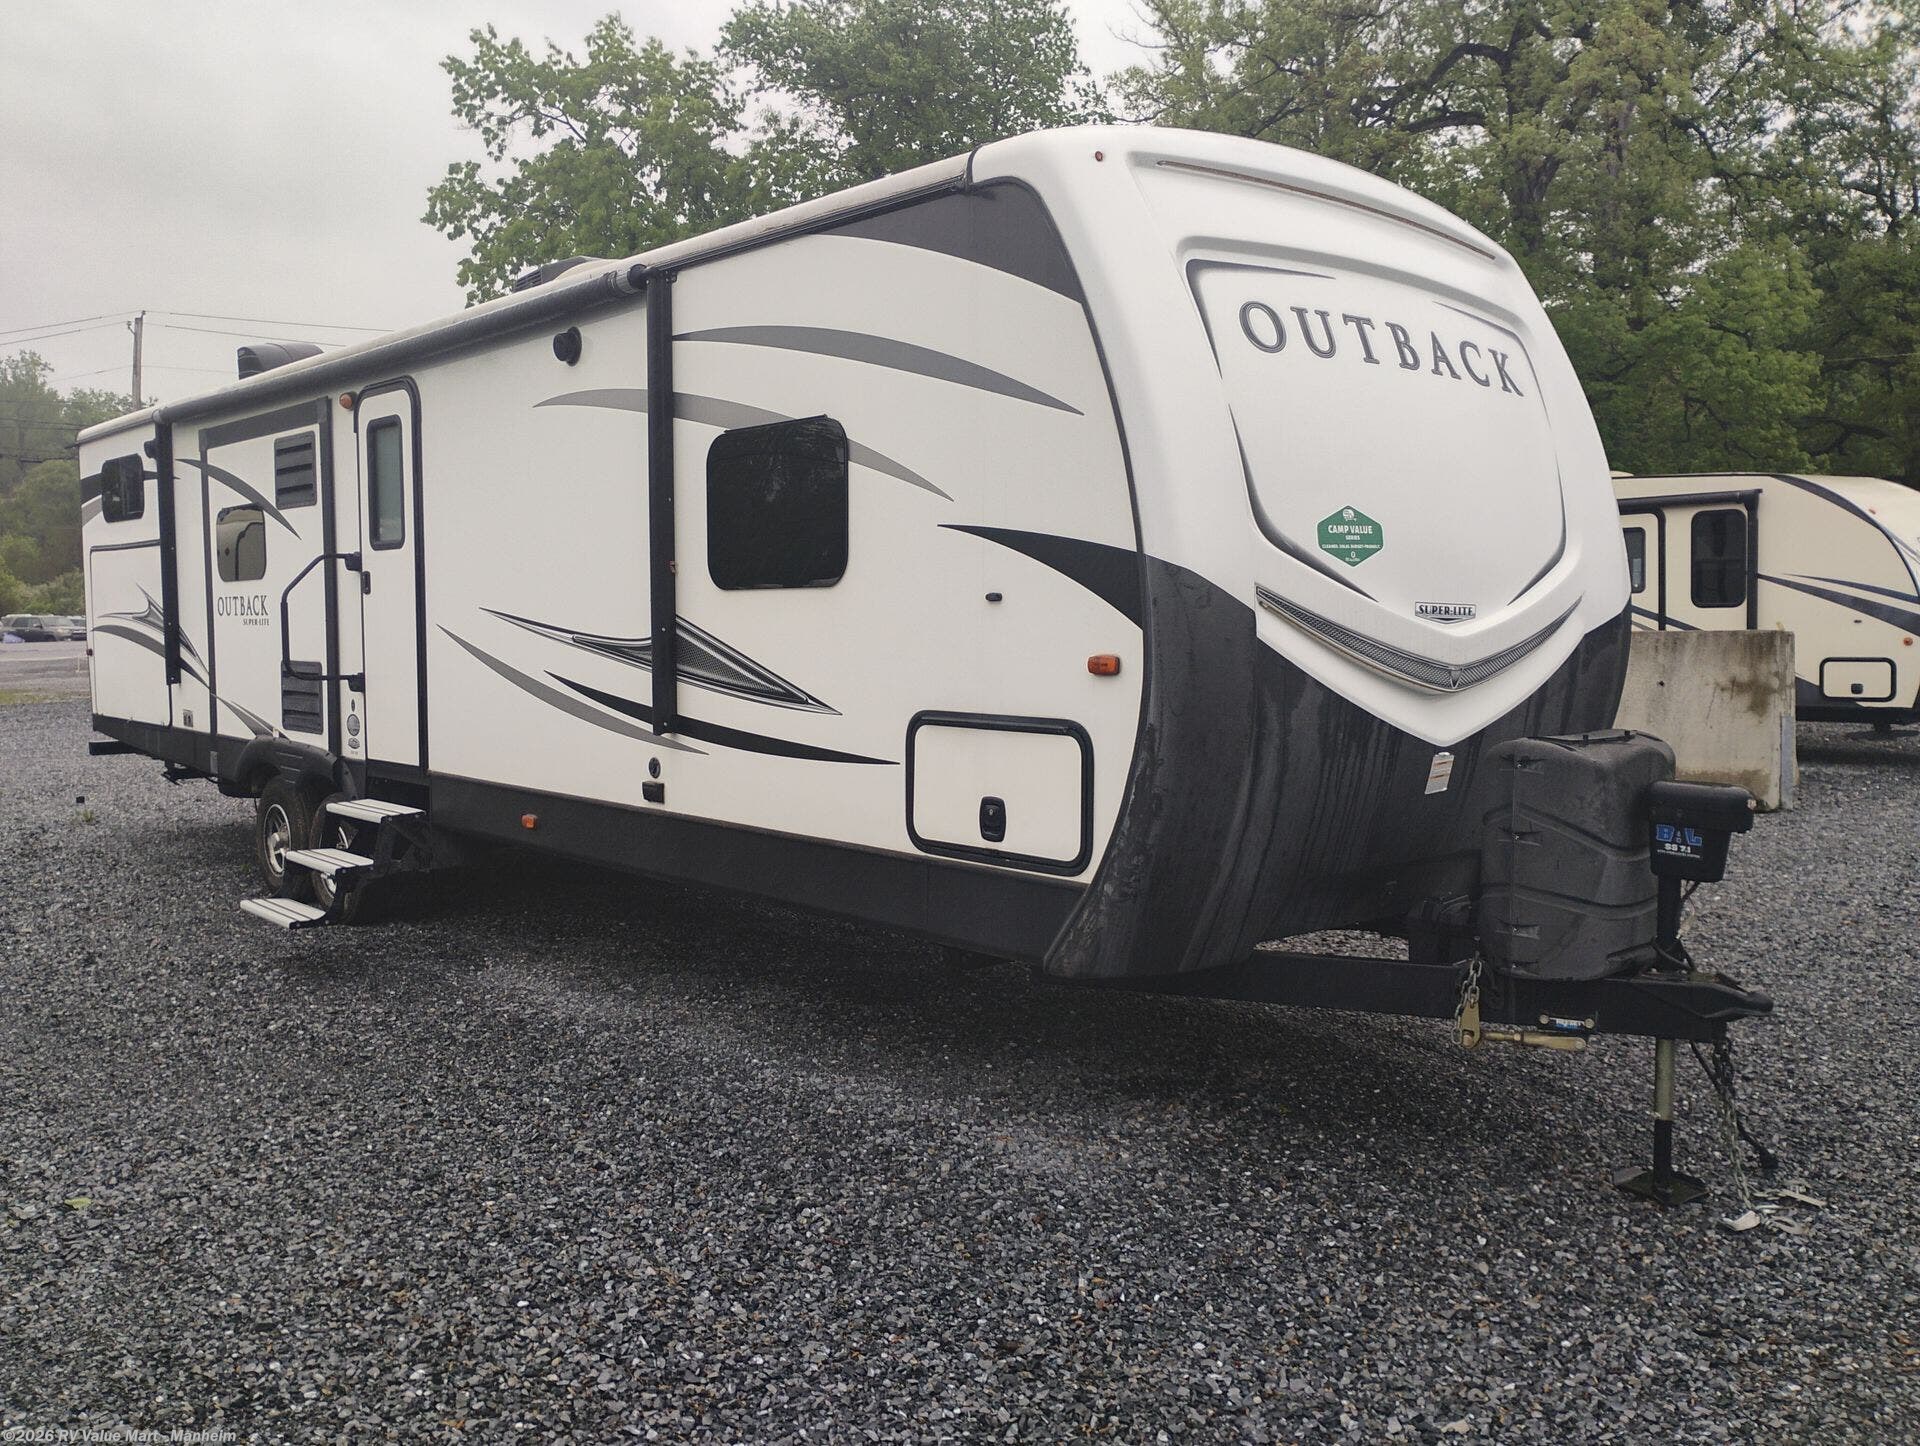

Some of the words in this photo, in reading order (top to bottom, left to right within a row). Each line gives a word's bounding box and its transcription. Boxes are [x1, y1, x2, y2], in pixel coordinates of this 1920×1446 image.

[1239, 300, 1524, 397] OUTBACK
[1328, 524, 1349, 534] CAMP
[1350, 525, 1373, 534] VALUE
[217, 595, 269, 617] OUTBACK
[1418, 604, 1473, 616] SUPER-LITE
